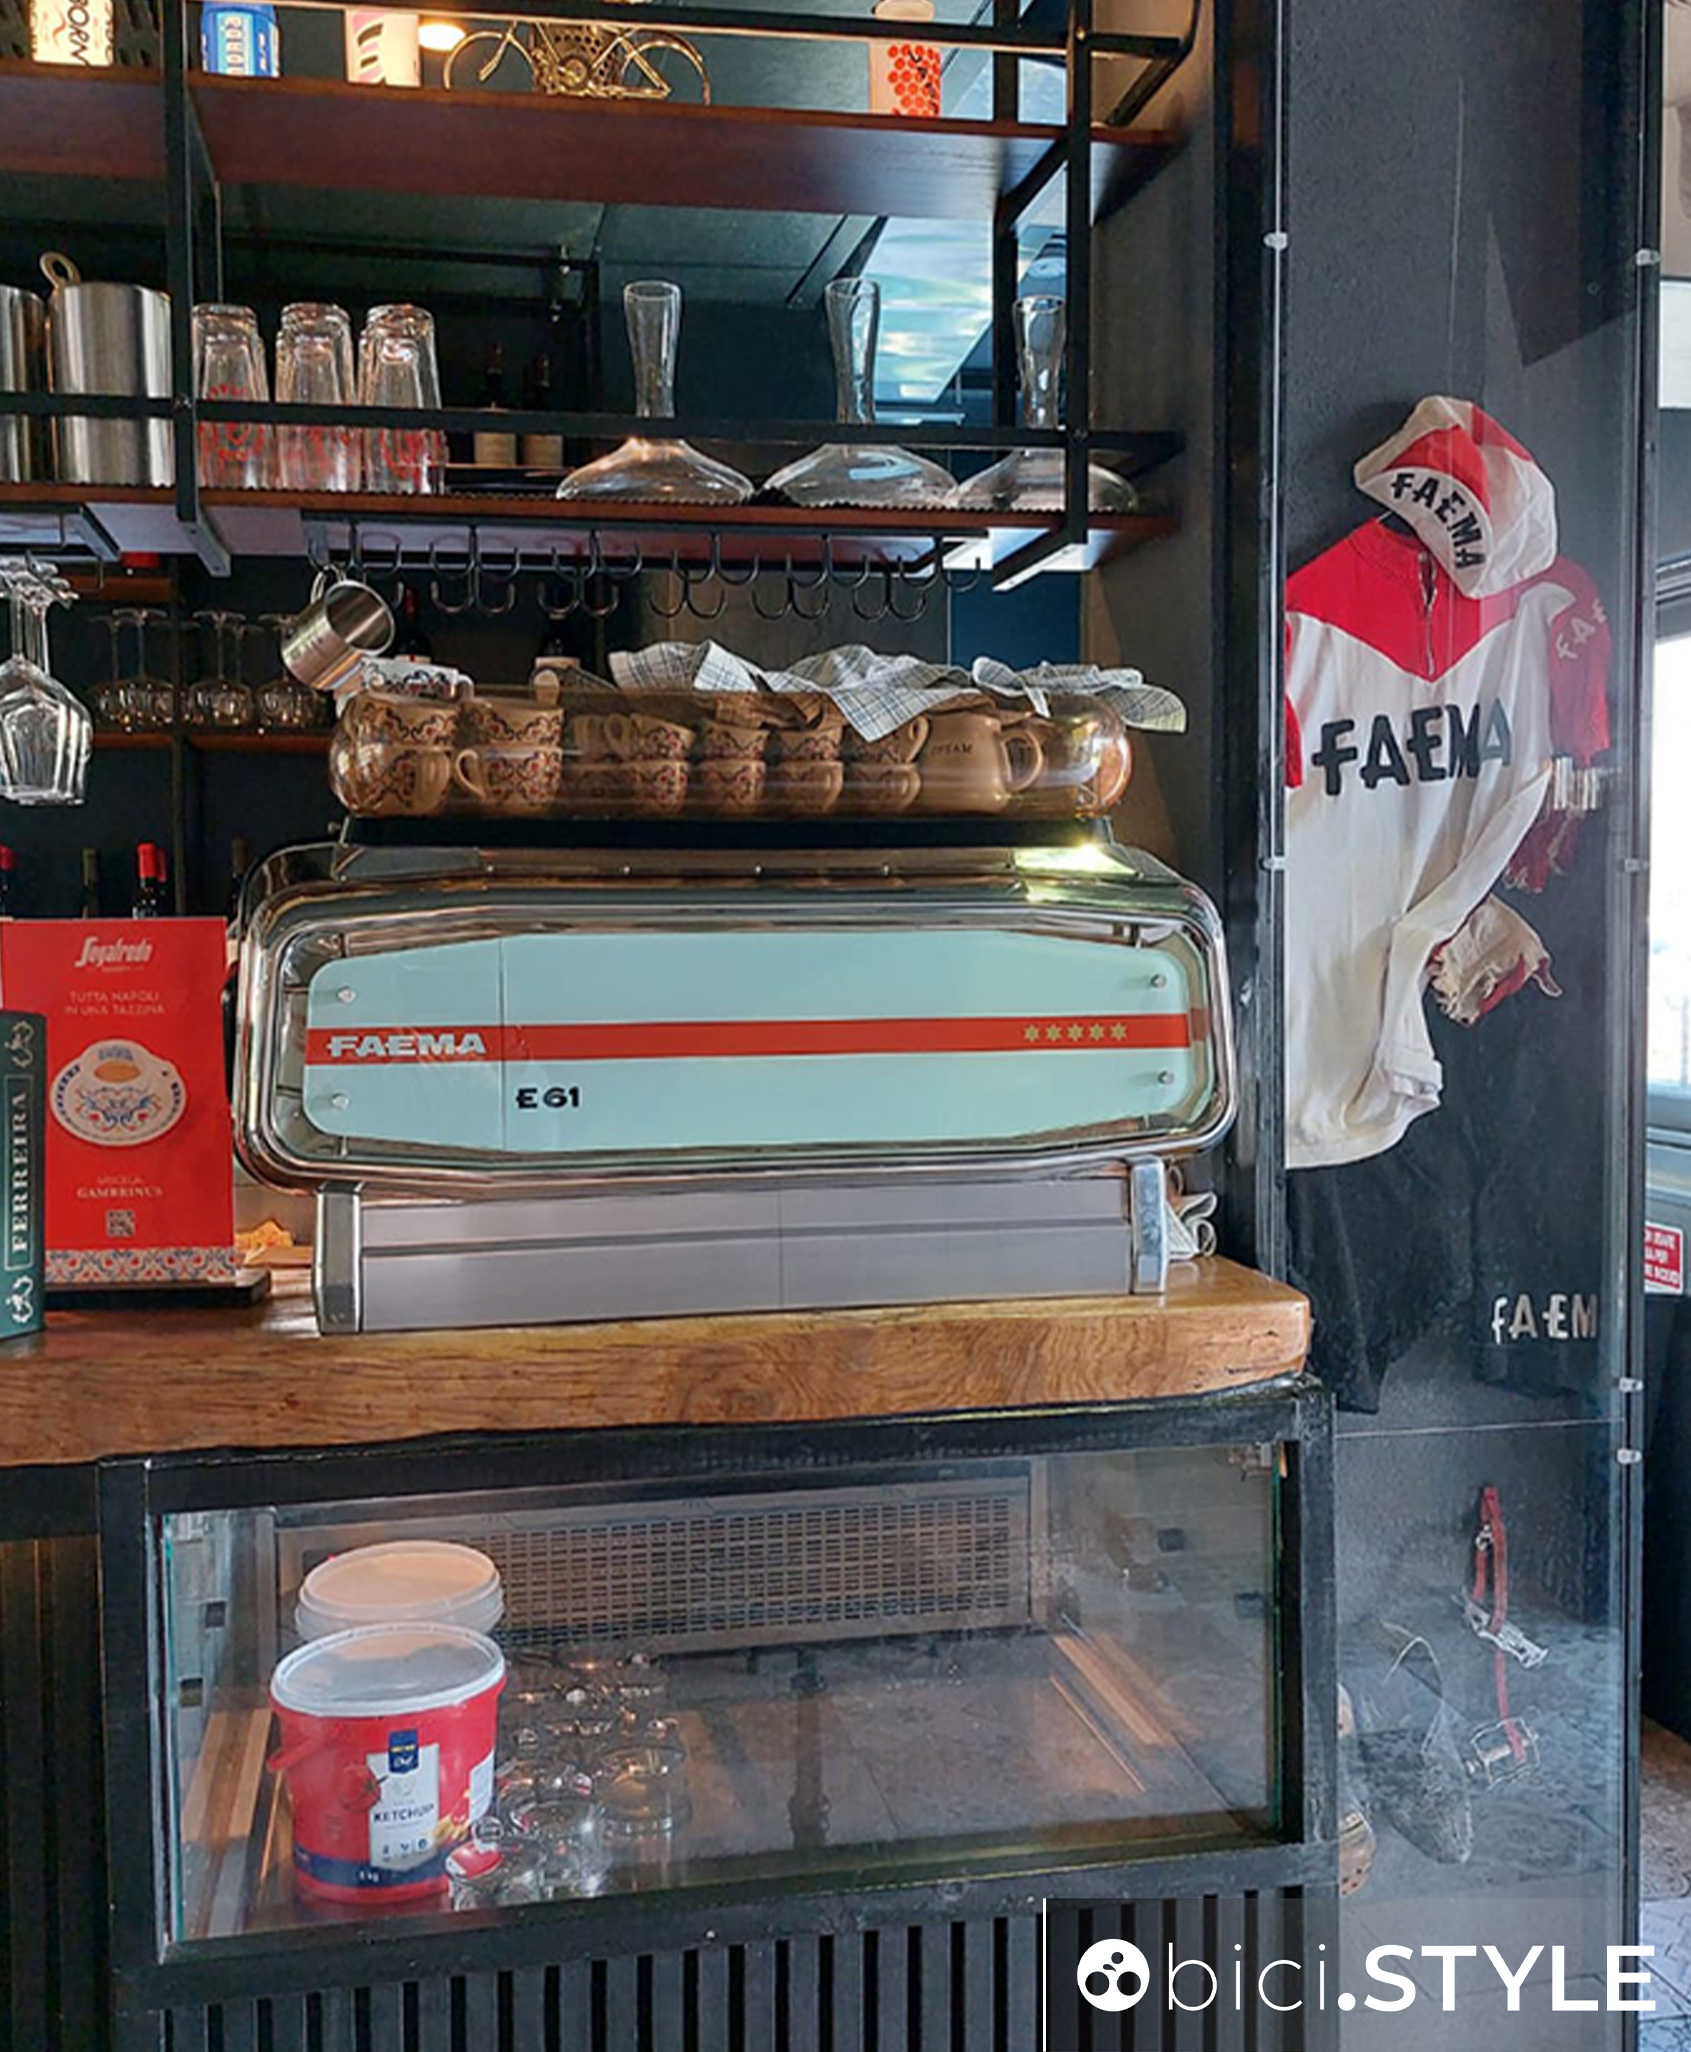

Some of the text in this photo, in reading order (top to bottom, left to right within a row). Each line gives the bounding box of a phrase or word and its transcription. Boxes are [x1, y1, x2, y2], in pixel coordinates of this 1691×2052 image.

[1390, 473, 1486, 569] FAEMA
[1311, 697, 1511, 796] FAEMA
[327, 1033, 487, 1057] FAEMA
[12, 1092, 29, 1254] FERREIRA
[372, 1803, 435, 1823] KETCHUP
